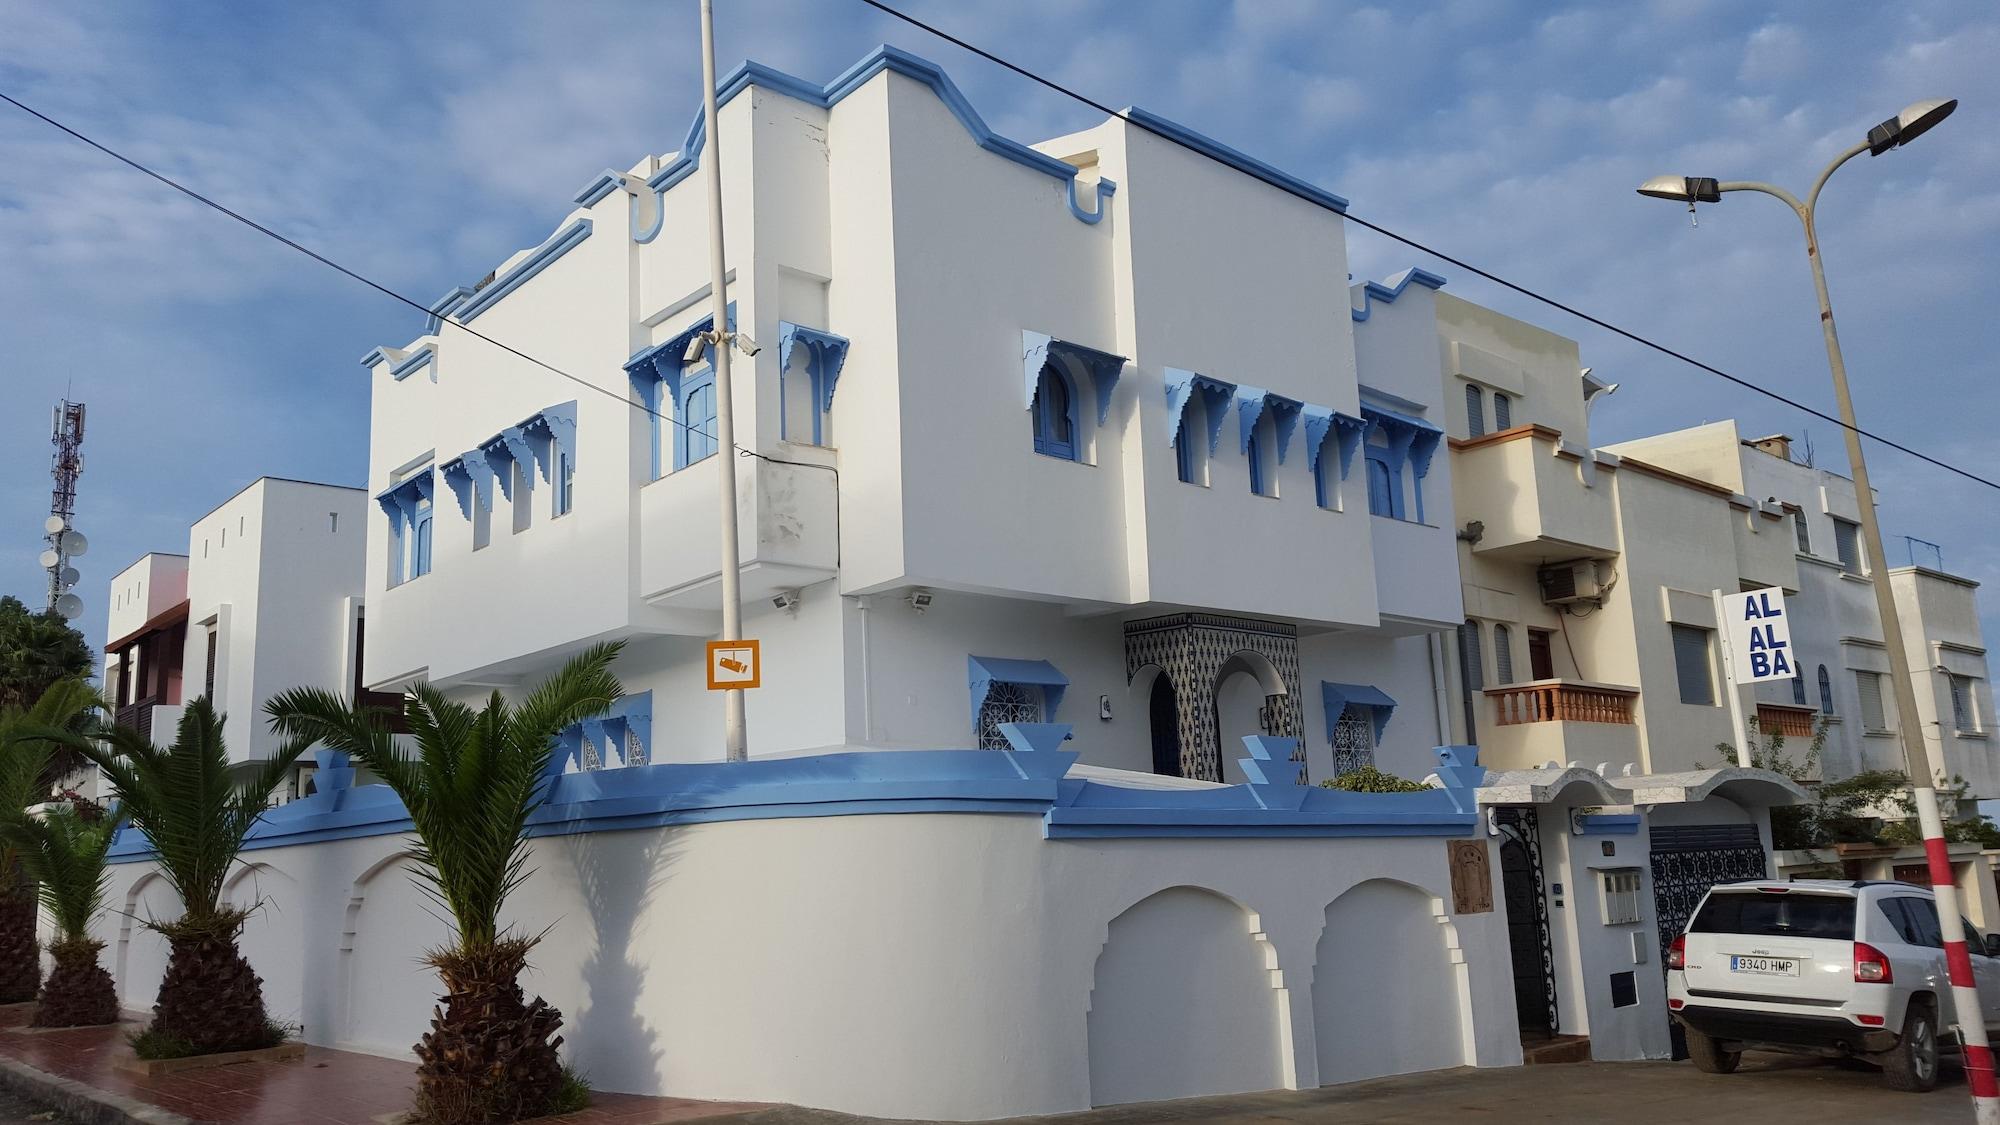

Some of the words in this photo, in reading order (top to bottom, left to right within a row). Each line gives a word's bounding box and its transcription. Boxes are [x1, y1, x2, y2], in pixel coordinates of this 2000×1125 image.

[1745, 593, 1782, 620] AL
[1750, 624, 1787, 652] AL
[1750, 649, 1791, 677] BA
[1739, 958, 1767, 971] 9340
[1770, 960, 1793, 972] HMP
